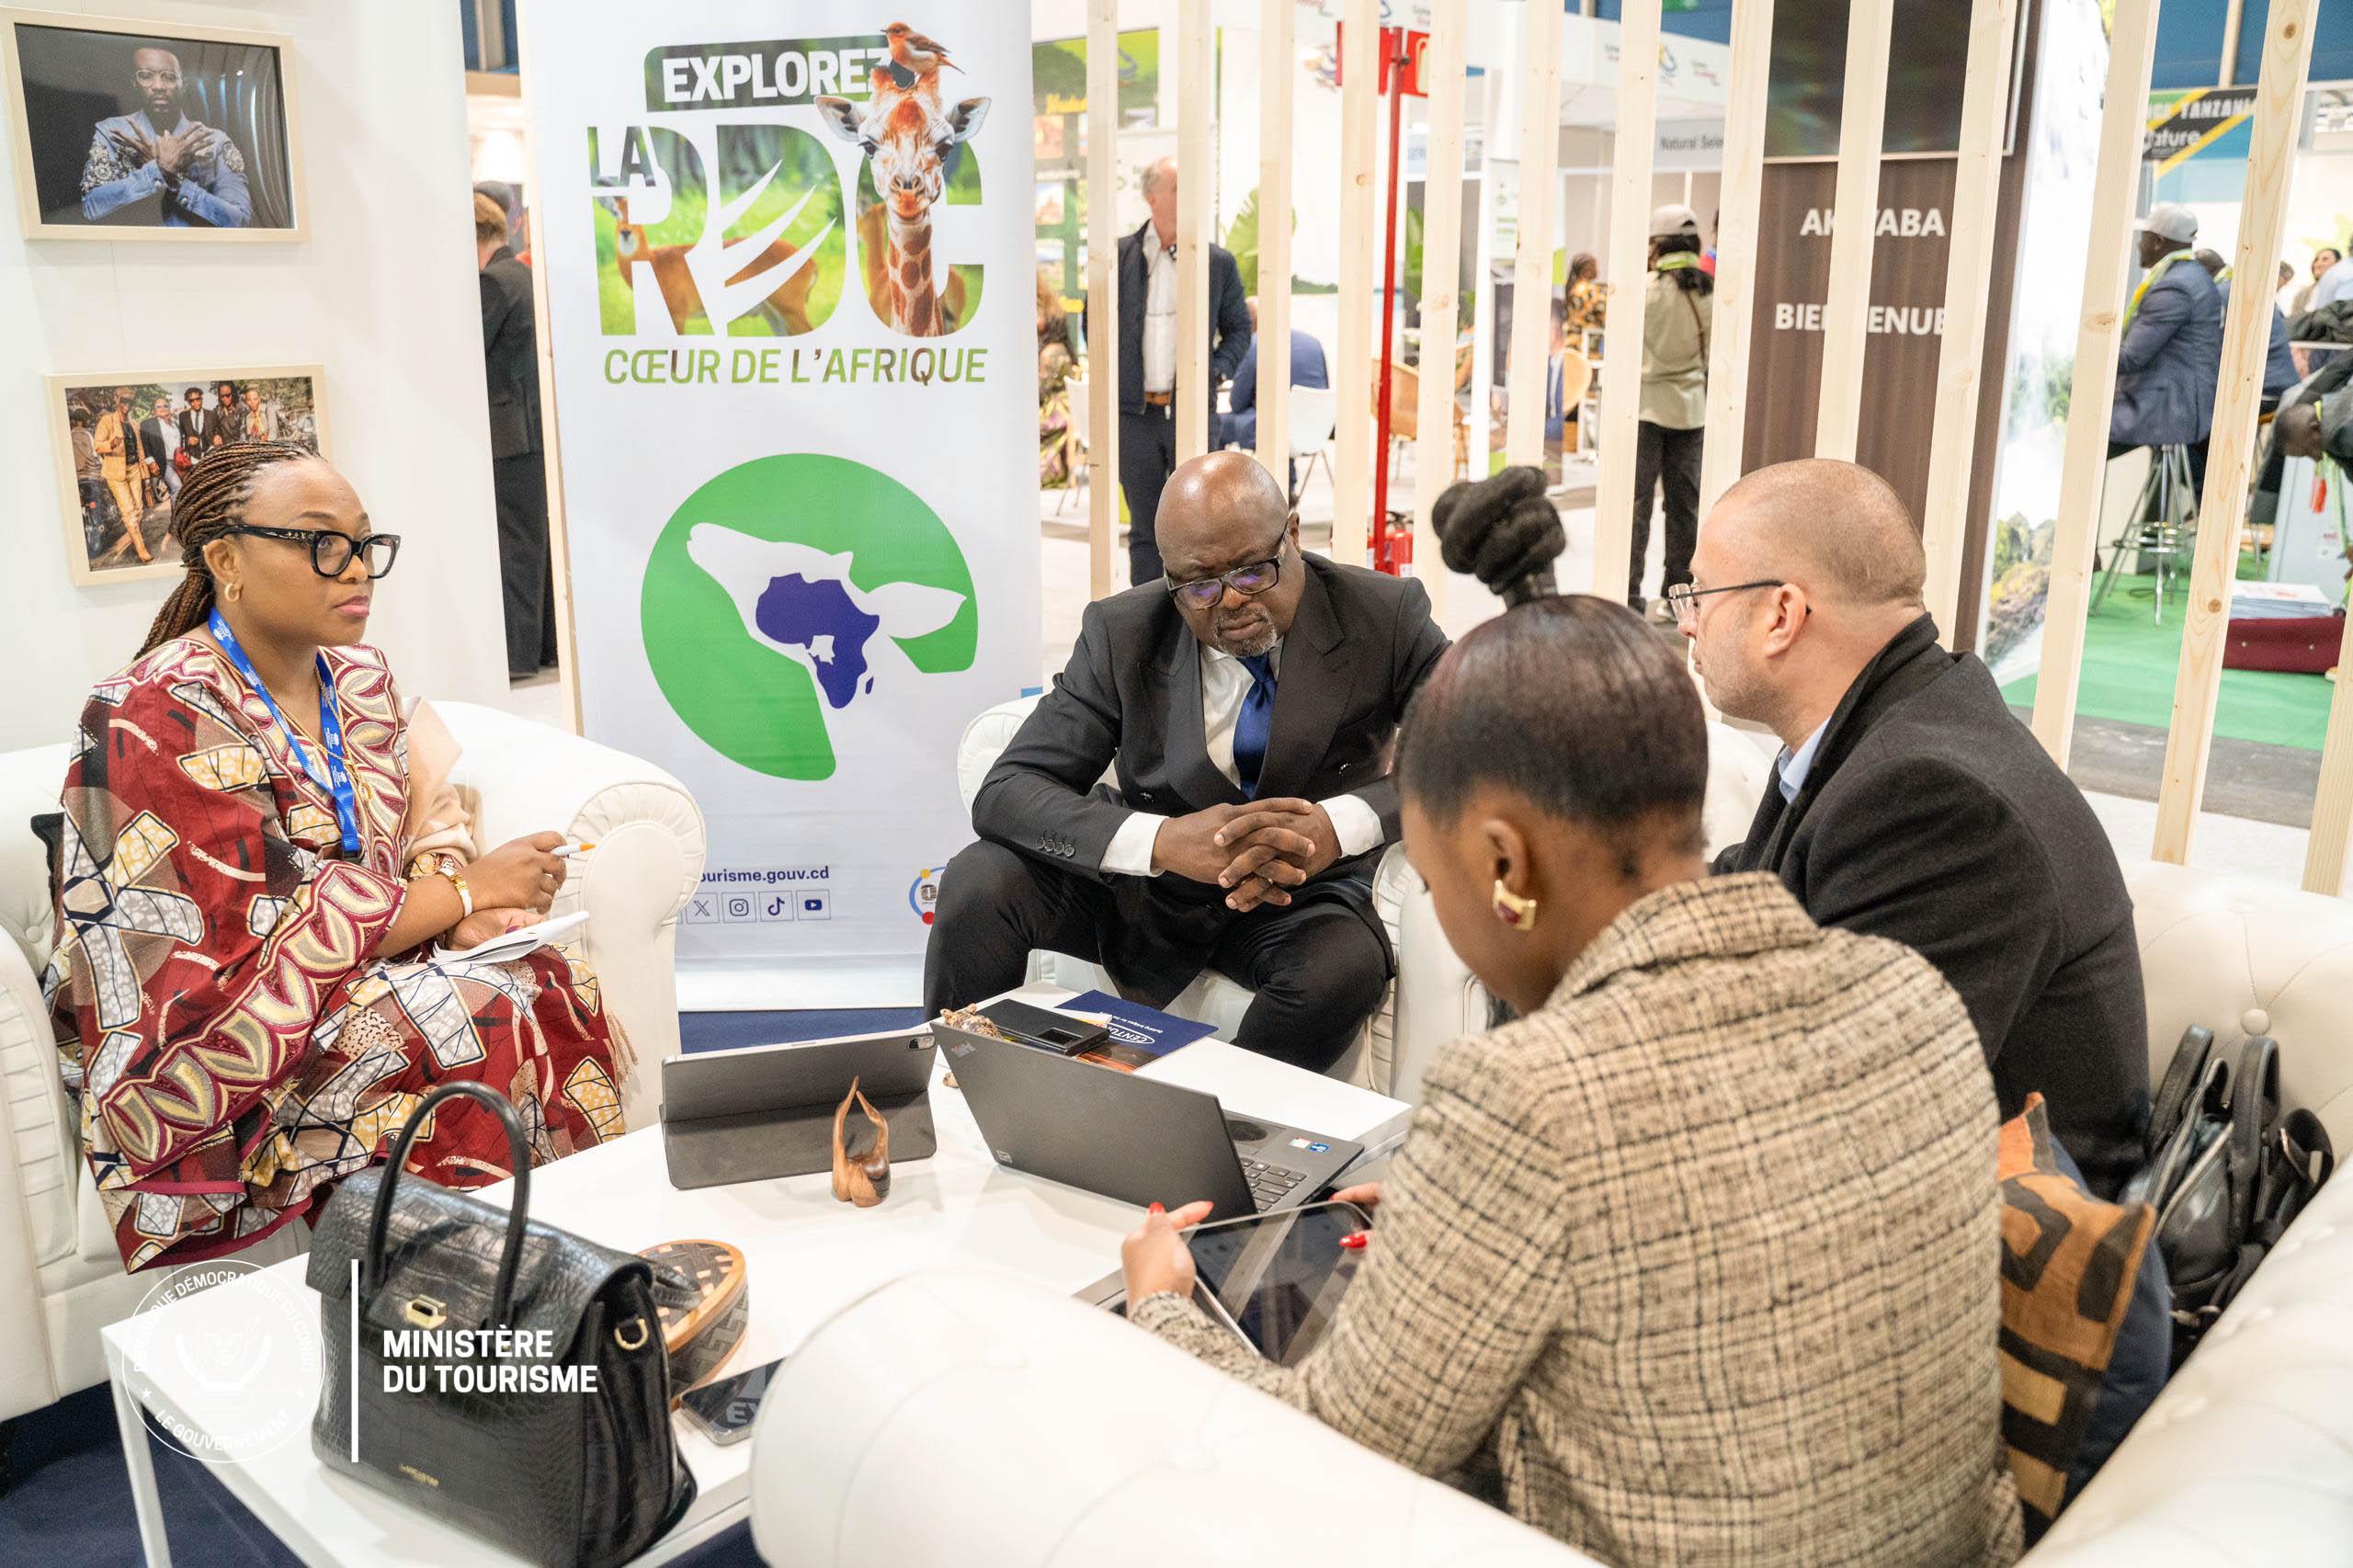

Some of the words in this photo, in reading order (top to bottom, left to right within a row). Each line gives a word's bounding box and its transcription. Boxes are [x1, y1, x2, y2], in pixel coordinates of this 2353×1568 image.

[587, 125, 656, 187] LA
[592, 124, 984, 337] RDC
[1800, 208, 1946, 237] AKABA
[1775, 302, 1944, 335] BIEENUE
[604, 348, 721, 384] CŒUR
[731, 348, 781, 383] DE
[1108, 1026, 1148, 1042] CENTU
